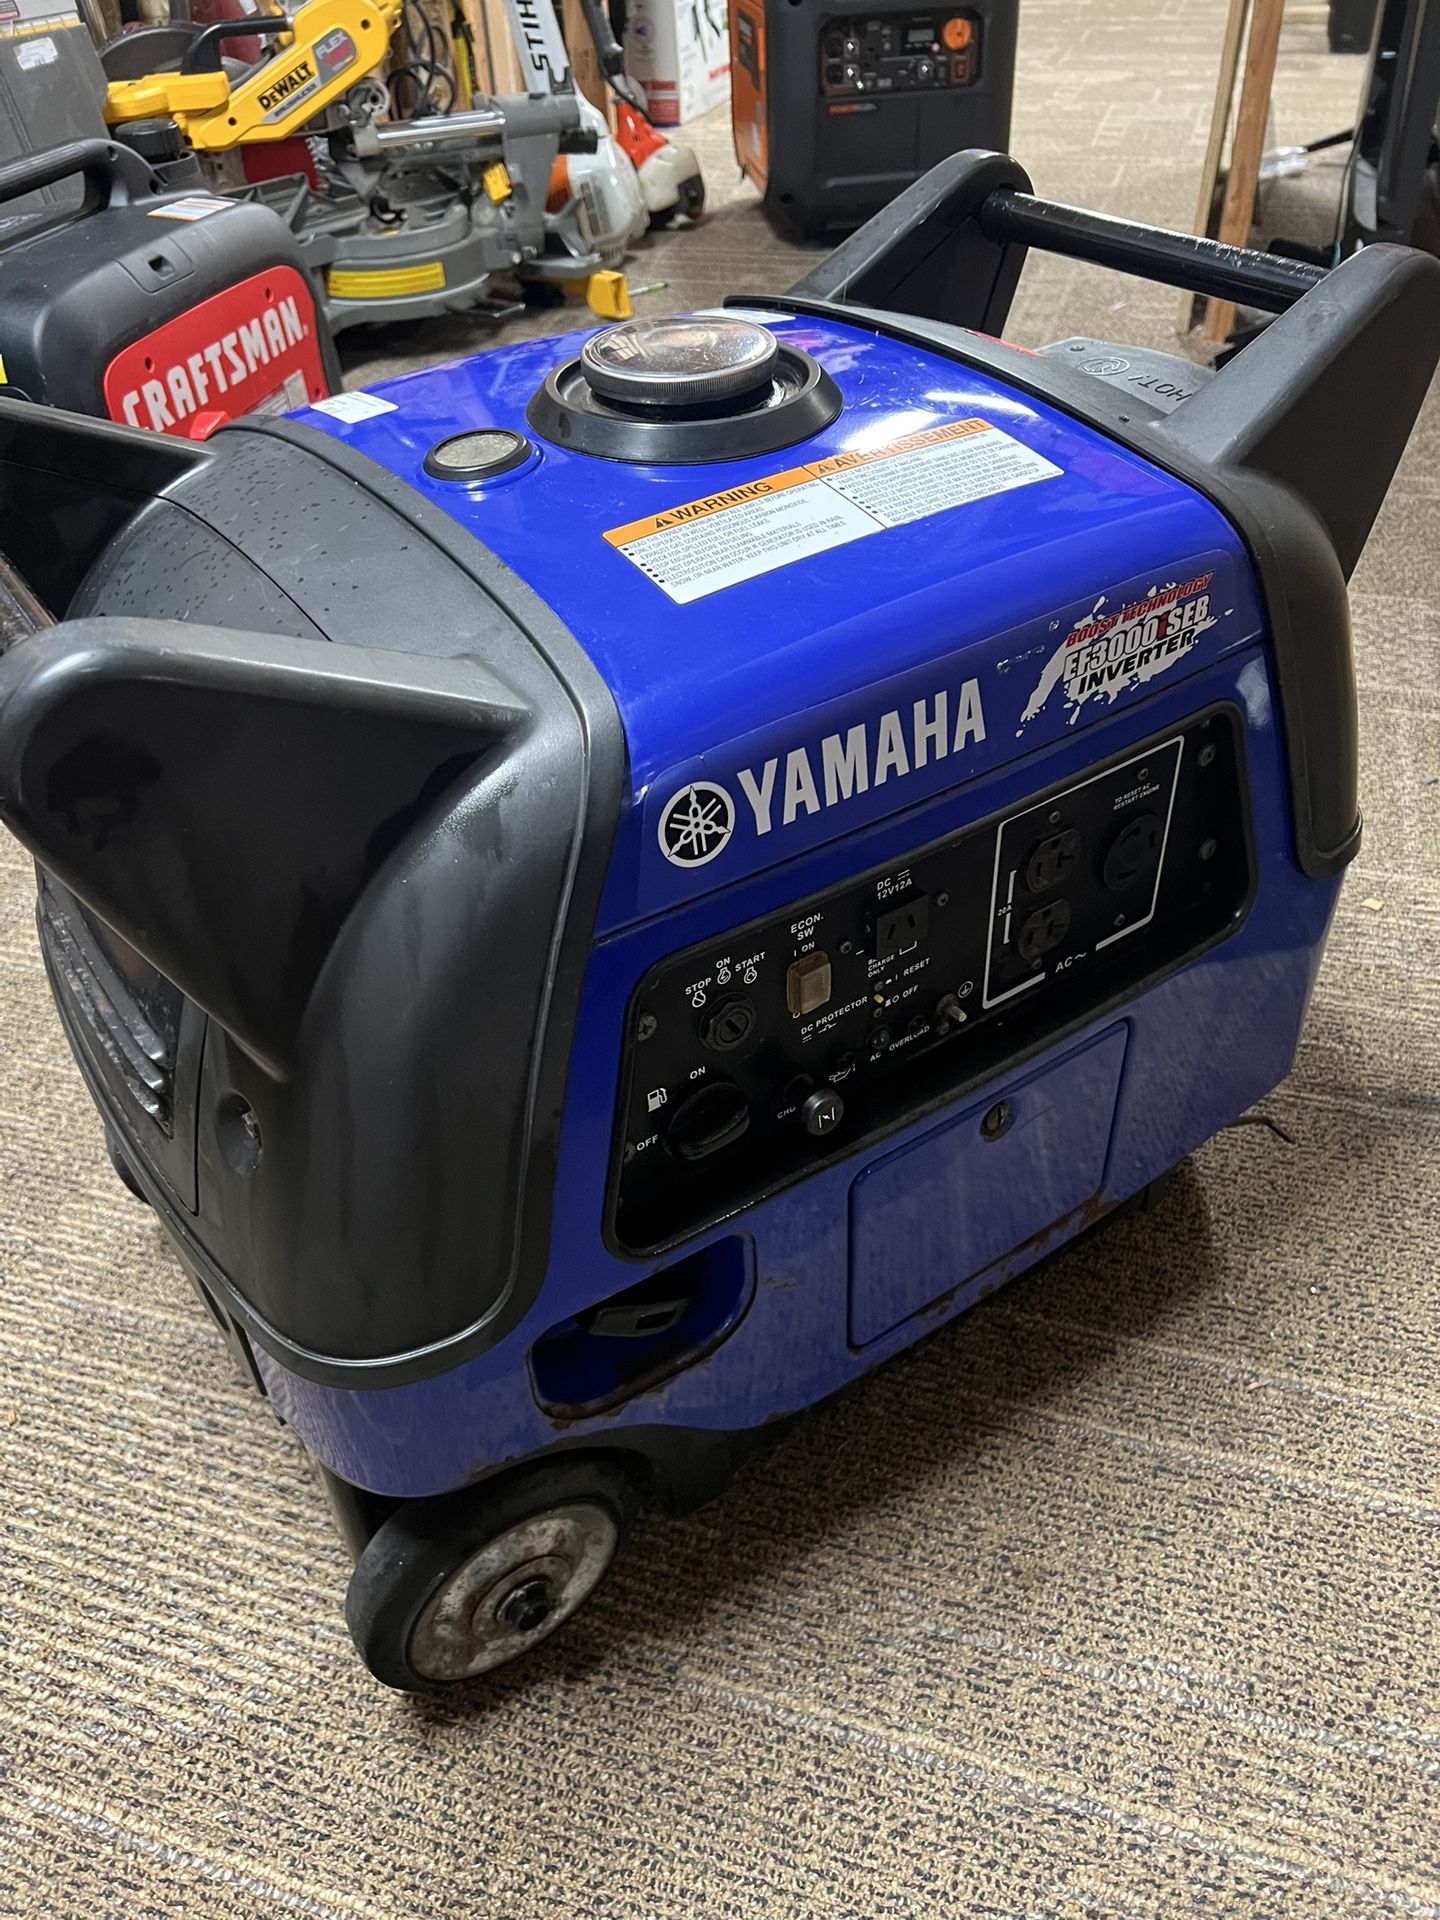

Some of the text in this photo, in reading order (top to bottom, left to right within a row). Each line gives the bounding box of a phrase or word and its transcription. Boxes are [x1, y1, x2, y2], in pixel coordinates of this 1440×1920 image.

[516, 0, 552, 71] STIH
[257, 61, 314, 111] DEWALT
[668, 481, 774, 521] WARNING
[1065, 573, 1214, 649] BOOST TECHNOLOGY
[1062, 593, 1211, 684] EF3000iSEB
[1077, 626, 1196, 696] INVERTER
[736, 677, 987, 837] YAMAHA
[877, 878, 892, 891] DC
[877, 878, 913, 900] 12V12A
[790, 913, 824, 934] ECON.
[797, 926, 815, 941] SW
[801, 941, 815, 953] ON
[716, 957, 732, 970] ON
[734, 951, 767, 972] START
[868, 954, 895, 972] CHARGE
[903, 957, 931, 977] RESET
[867, 965, 886, 979] ONLY
[684, 977, 712, 996] STOP
[902, 984, 919, 999] OFF
[800, 996, 869, 1036] DC PROTECTOR
[689, 1066, 706, 1080] ON
[636, 1134, 660, 1152] OFF
